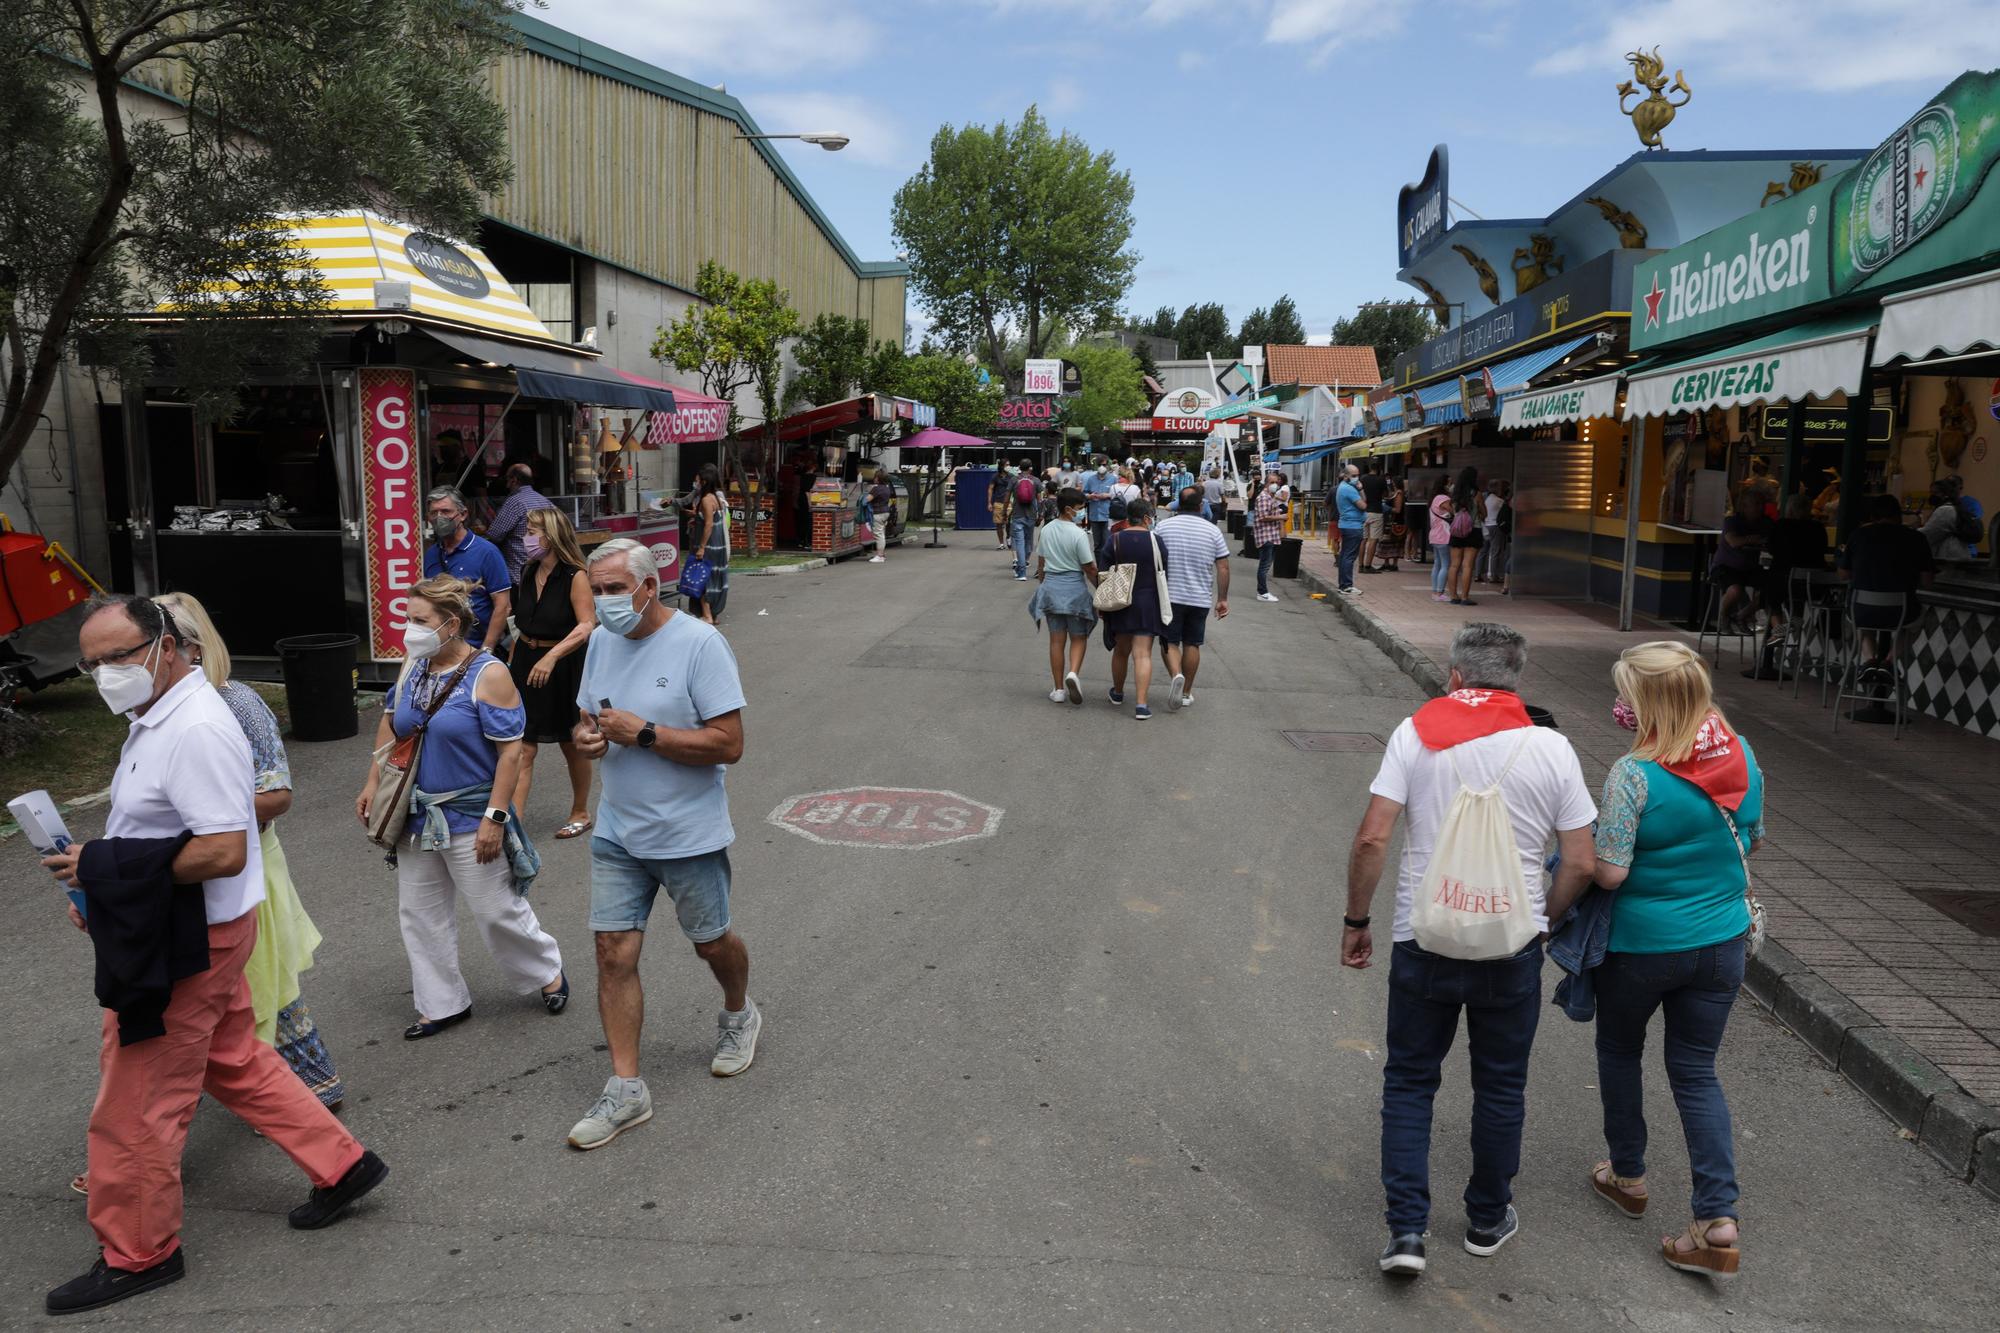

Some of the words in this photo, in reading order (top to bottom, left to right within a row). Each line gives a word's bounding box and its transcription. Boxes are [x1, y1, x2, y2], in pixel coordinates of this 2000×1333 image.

[1894, 132, 1909, 247] Heineken
[1666, 228, 1810, 324] Heineken
[1441, 328, 1474, 367] CALAMRES
[1494, 311, 1515, 344] FERIA
[1671, 359, 1780, 405] CERVEZAS
[672, 408, 717, 435] GOFERS
[1164, 419, 1178, 430] EL
[1179, 419, 1210, 430] CUCO
[376, 396, 412, 630] GOFRES
[803, 800, 972, 833] STOP
[1433, 879, 1513, 914] MIERES
